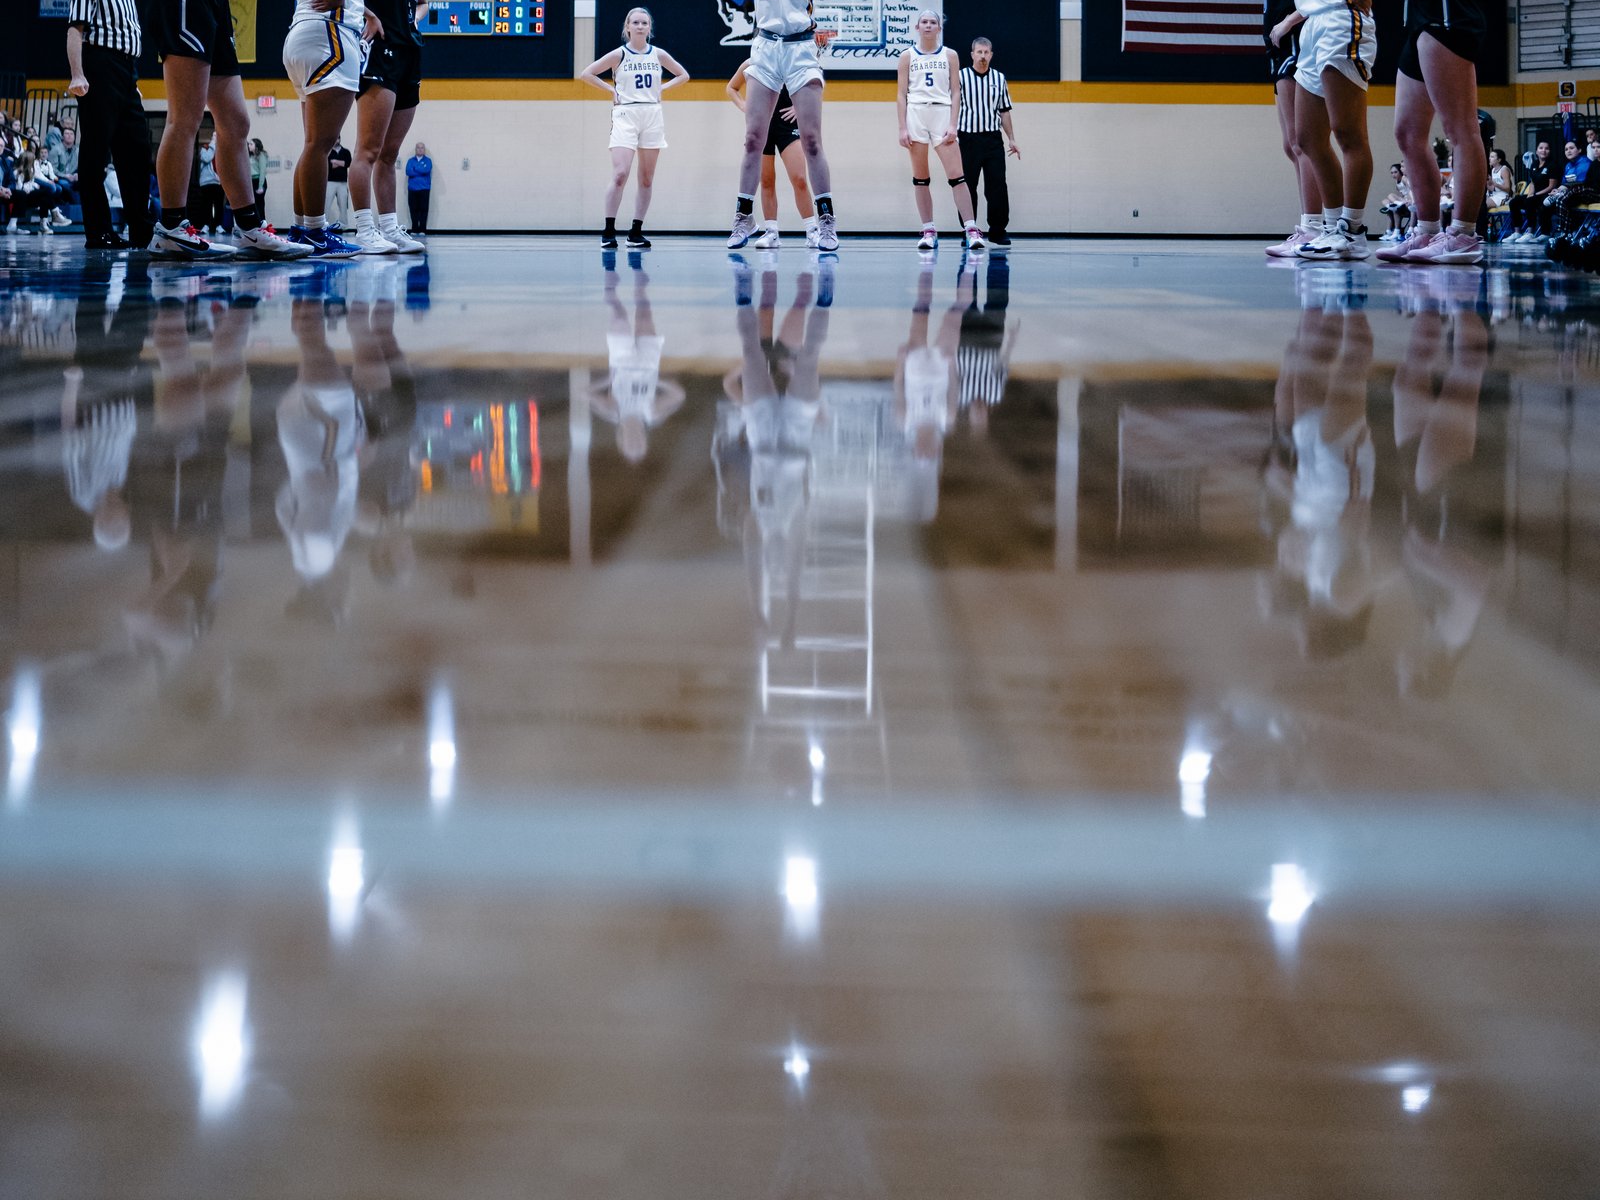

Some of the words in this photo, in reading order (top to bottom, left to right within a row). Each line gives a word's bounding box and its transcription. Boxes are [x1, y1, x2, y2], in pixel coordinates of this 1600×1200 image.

[428, 2, 450, 10] FOULS
[469, 2, 491, 10] FOULS
[478, 10, 489, 25] 4
[499, 7, 510, 18] 15
[516, 7, 524, 18] 0
[536, 7, 544, 18] 0
[450, 14, 457, 25] 4
[884, 15, 910, 23] Thing!
[449, 25, 462, 33] TOL
[495, 22, 510, 33] 20
[516, 22, 524, 33] 0
[536, 22, 544, 33] 0
[888, 26, 910, 34] Ring!
[623, 62, 659, 72] CHARGERS
[910, 61, 947, 72] CHARGERS
[634, 73, 652, 89] 20
[924, 72, 934, 87] 5
[1563, 83, 1572, 96] 5
